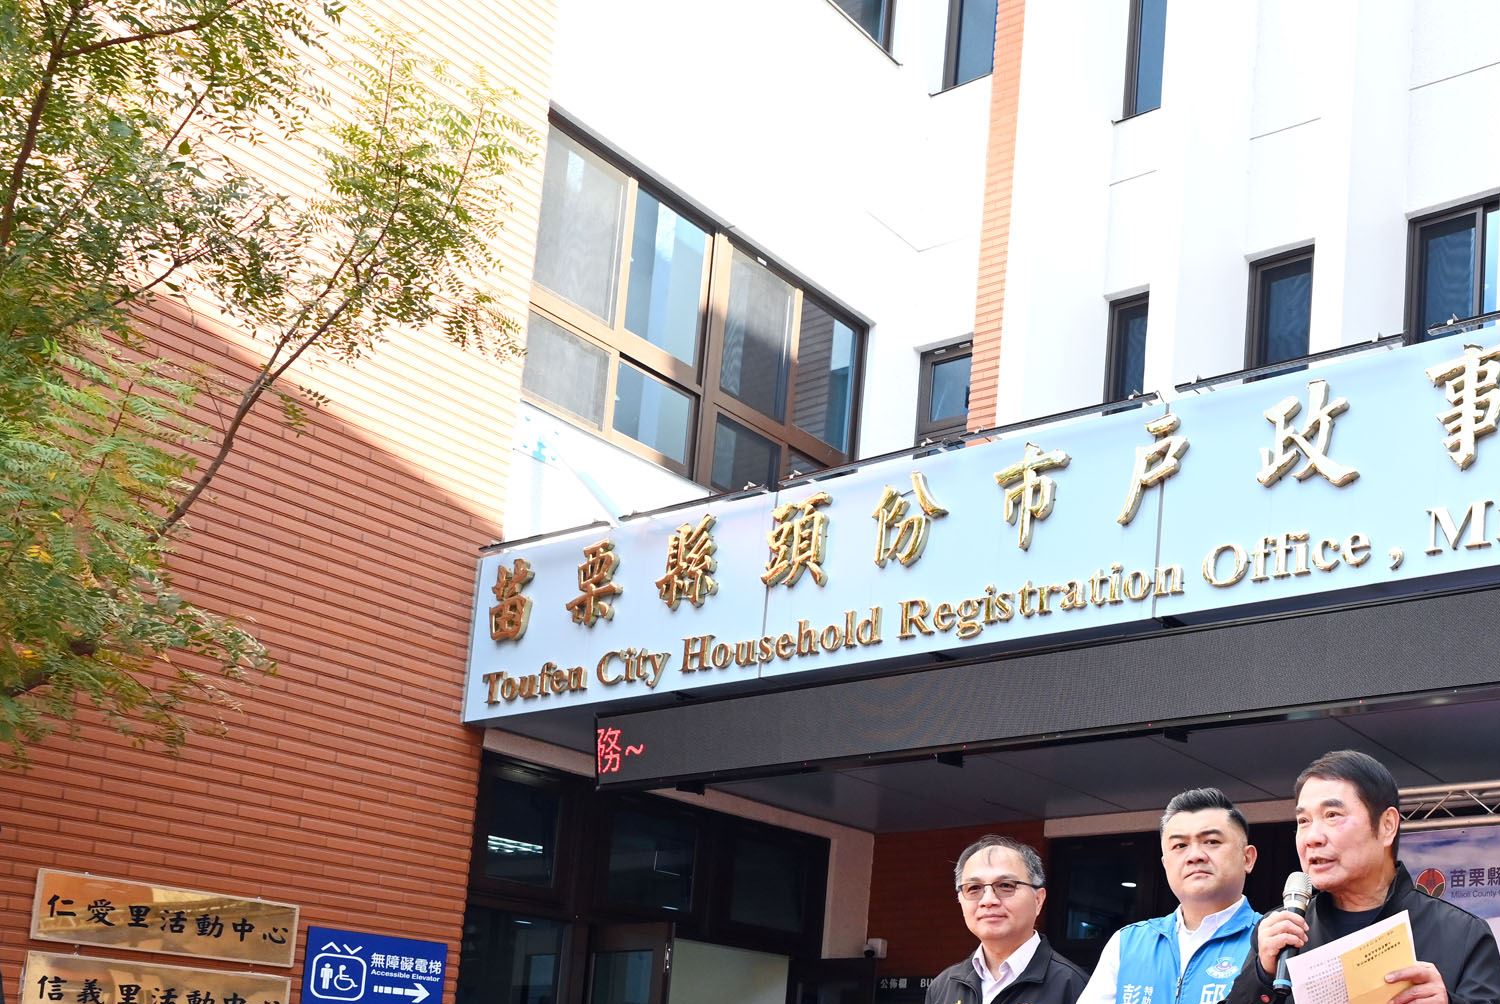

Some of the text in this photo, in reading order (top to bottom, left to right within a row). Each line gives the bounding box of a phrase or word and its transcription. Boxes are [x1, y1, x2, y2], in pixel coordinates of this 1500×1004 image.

[484, 661, 588, 705] Toufen
[596, 647, 672, 688] City
[681, 606, 883, 674] Household
[897, 562, 1186, 640] Registration
[1473, 889, 1497, 898] County
[47, 894, 290, 945] 仁愛里活動中心
[371, 952, 442, 975] 無障礙電梯
[371, 968, 440, 983] Accessible Elevator
